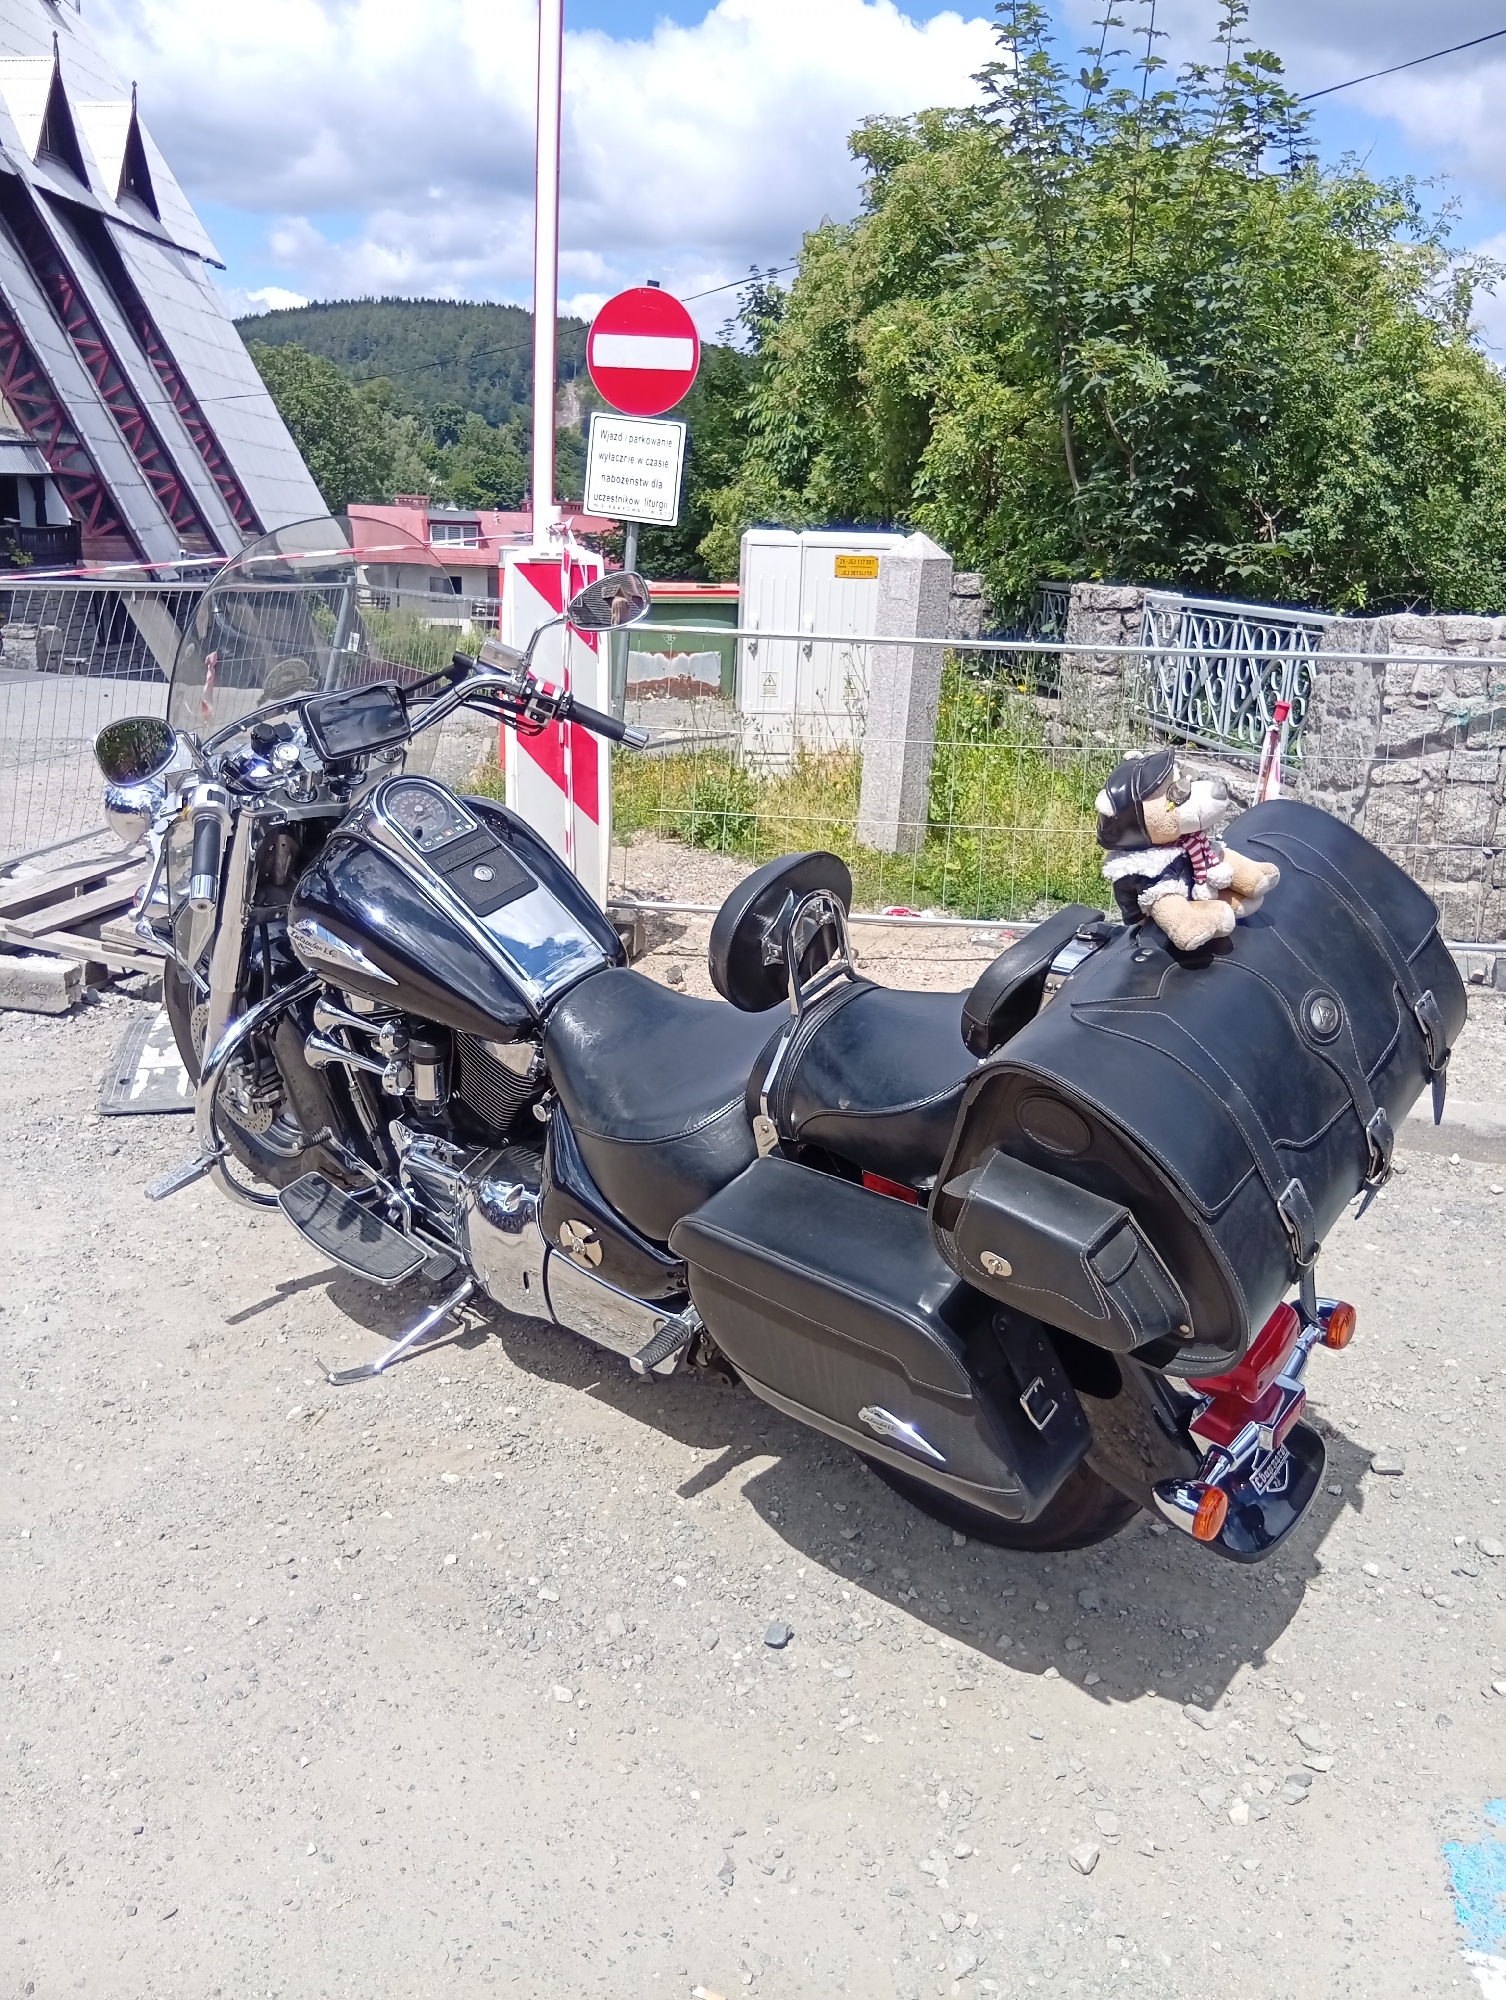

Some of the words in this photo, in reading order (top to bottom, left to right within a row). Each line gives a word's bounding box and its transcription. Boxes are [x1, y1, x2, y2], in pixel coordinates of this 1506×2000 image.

[600, 429, 623, 443] Wjazd
[628, 434, 673, 448] parkowanie
[636, 457, 644, 465] w
[645, 458, 669, 469] czasie
[651, 478, 663, 490] dla
[593, 493, 640, 505] uczestników
[644, 497, 669, 512] liturgii
